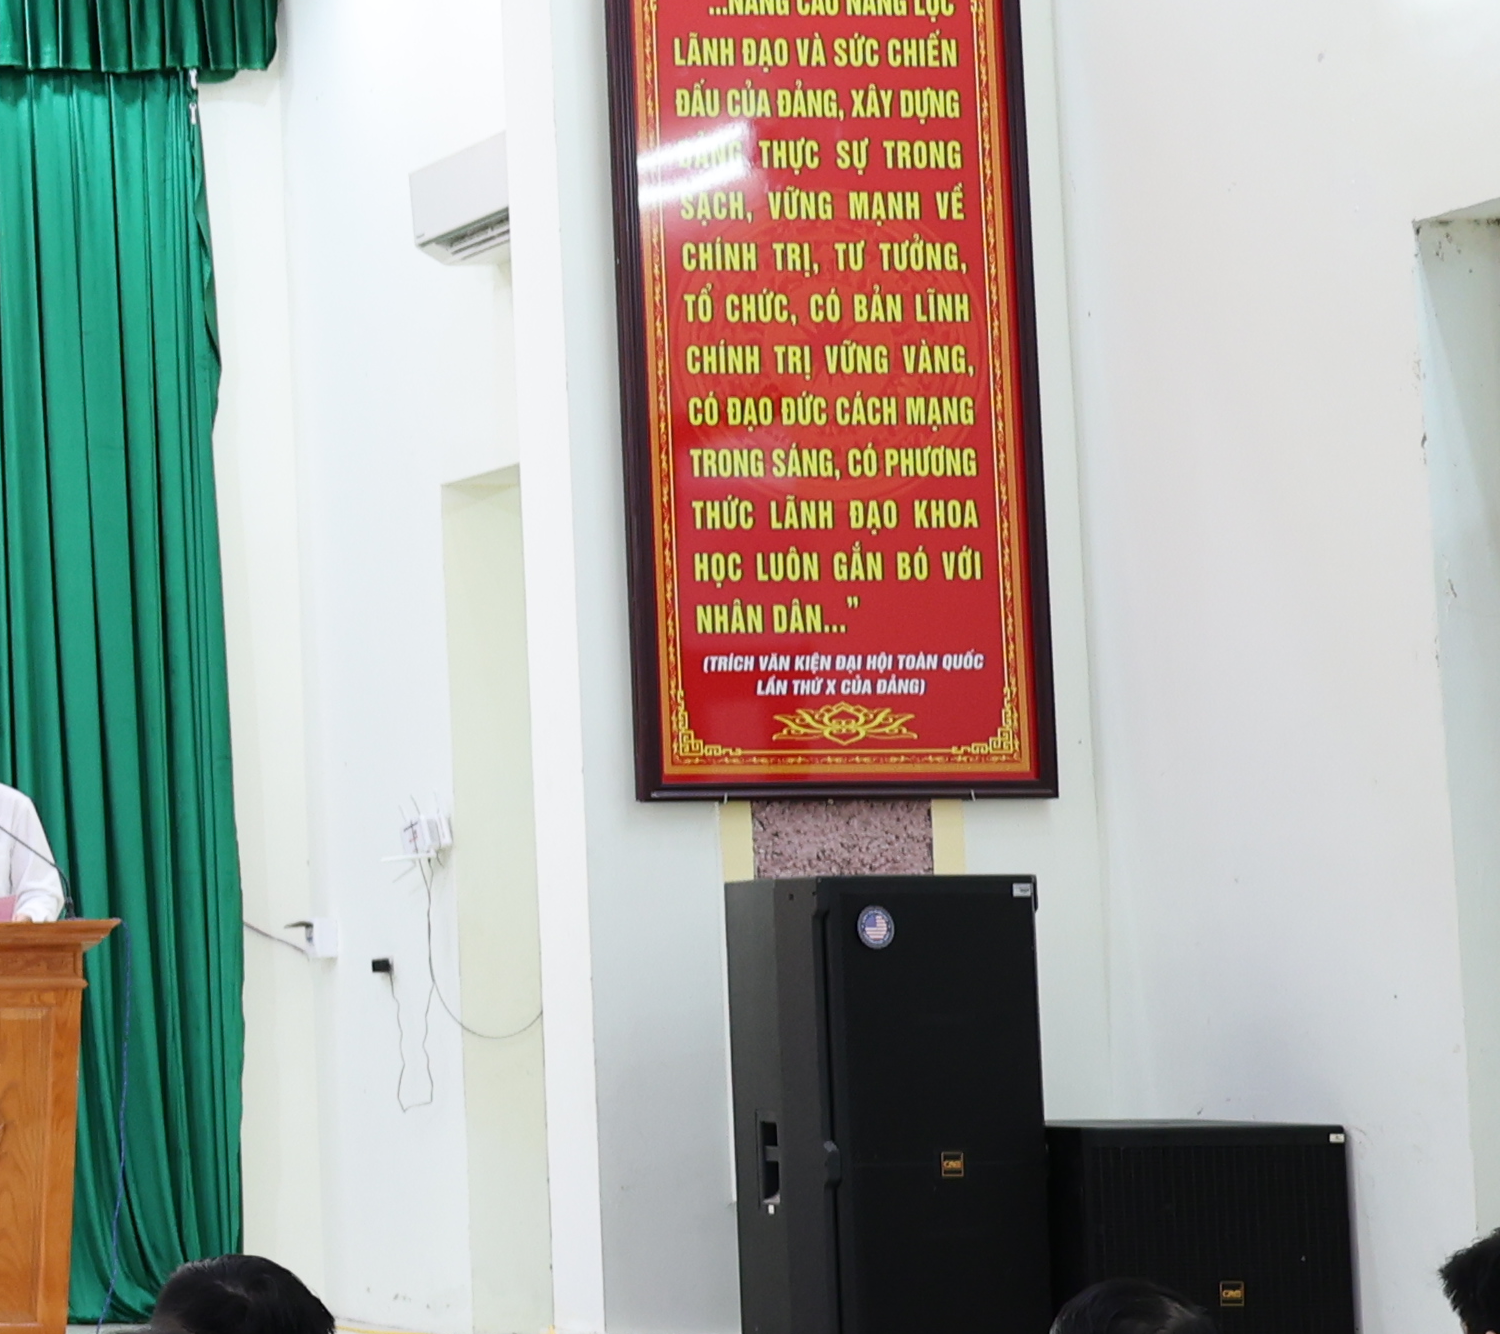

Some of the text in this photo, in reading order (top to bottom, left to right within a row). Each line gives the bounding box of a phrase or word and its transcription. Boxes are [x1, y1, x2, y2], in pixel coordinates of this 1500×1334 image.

[674, 31, 958, 71] LÃNH ĐẠO VÀ SỨC CHIẾN
[675, 81, 960, 124] ĐẤU CỦA ĐẢNG, XÂY DỰNG
[757, 136, 820, 175] THỰC
[835, 138, 870, 174] SỰ
[882, 139, 962, 170] TRONG
[680, 184, 965, 226] SẠCH, VỮNG MẠNH VỀ
[682, 233, 968, 277] CHÍNH TRỊ, TƯ TƯỞNG,
[683, 283, 971, 325] TỔ CHỨC, CÓ BẢN LĨNH
[685, 339, 975, 380] CHÍNH TRỊ VỮNG VÀNG,
[688, 391, 975, 431] CÓ ĐẠO ĐỨC CÁCH MẠNG
[690, 443, 977, 481] TRONG SÁNG, CÓ PHƯƠNG
[692, 495, 979, 534] THỨC LÃNH ĐẠO KHOA
[694, 544, 982, 586] HỌC LUÔN GẮN BÓ VỚI
[696, 599, 763, 634] NHÂN
